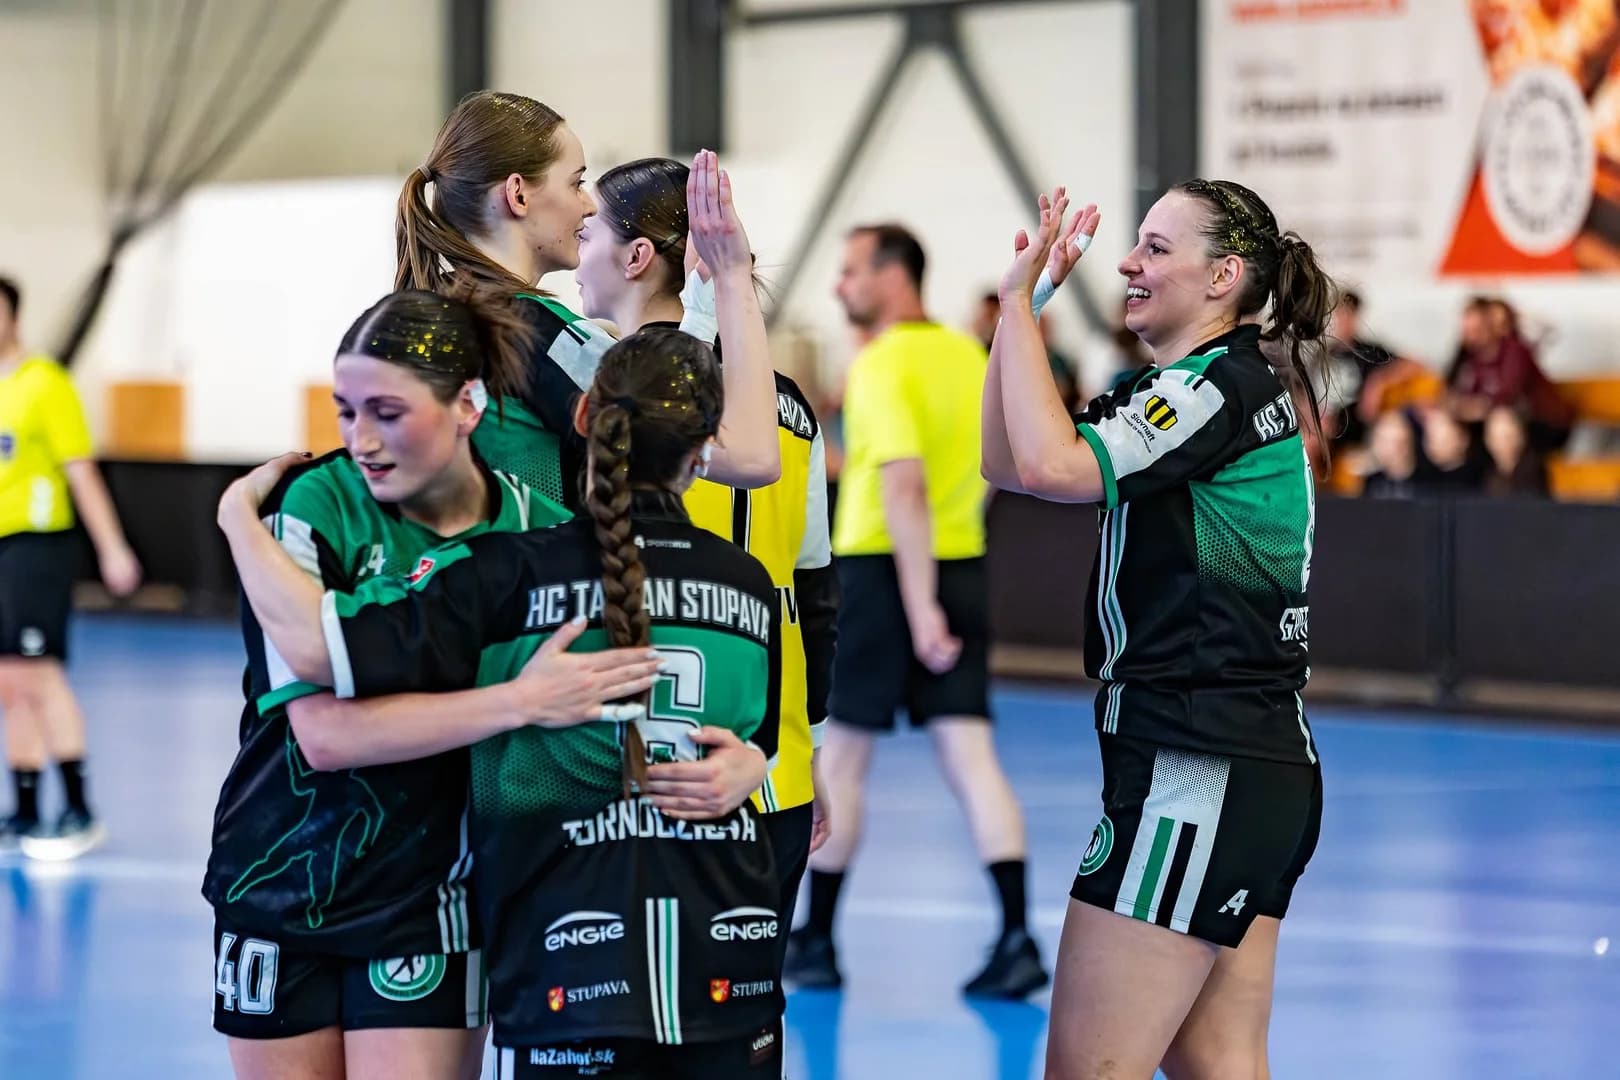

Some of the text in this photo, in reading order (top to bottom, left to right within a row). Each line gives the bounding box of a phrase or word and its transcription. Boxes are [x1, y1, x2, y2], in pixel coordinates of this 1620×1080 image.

[1131, 413, 1155, 442] Slovnaft
[525, 584, 567, 629] HC
[571, 578, 675, 619] TAAN
[681, 580, 770, 645] STUPAVA
[216, 932, 280, 1015] 40
[566, 980, 631, 1003] STUPAVA
[732, 980, 774, 998] STUPAVA
